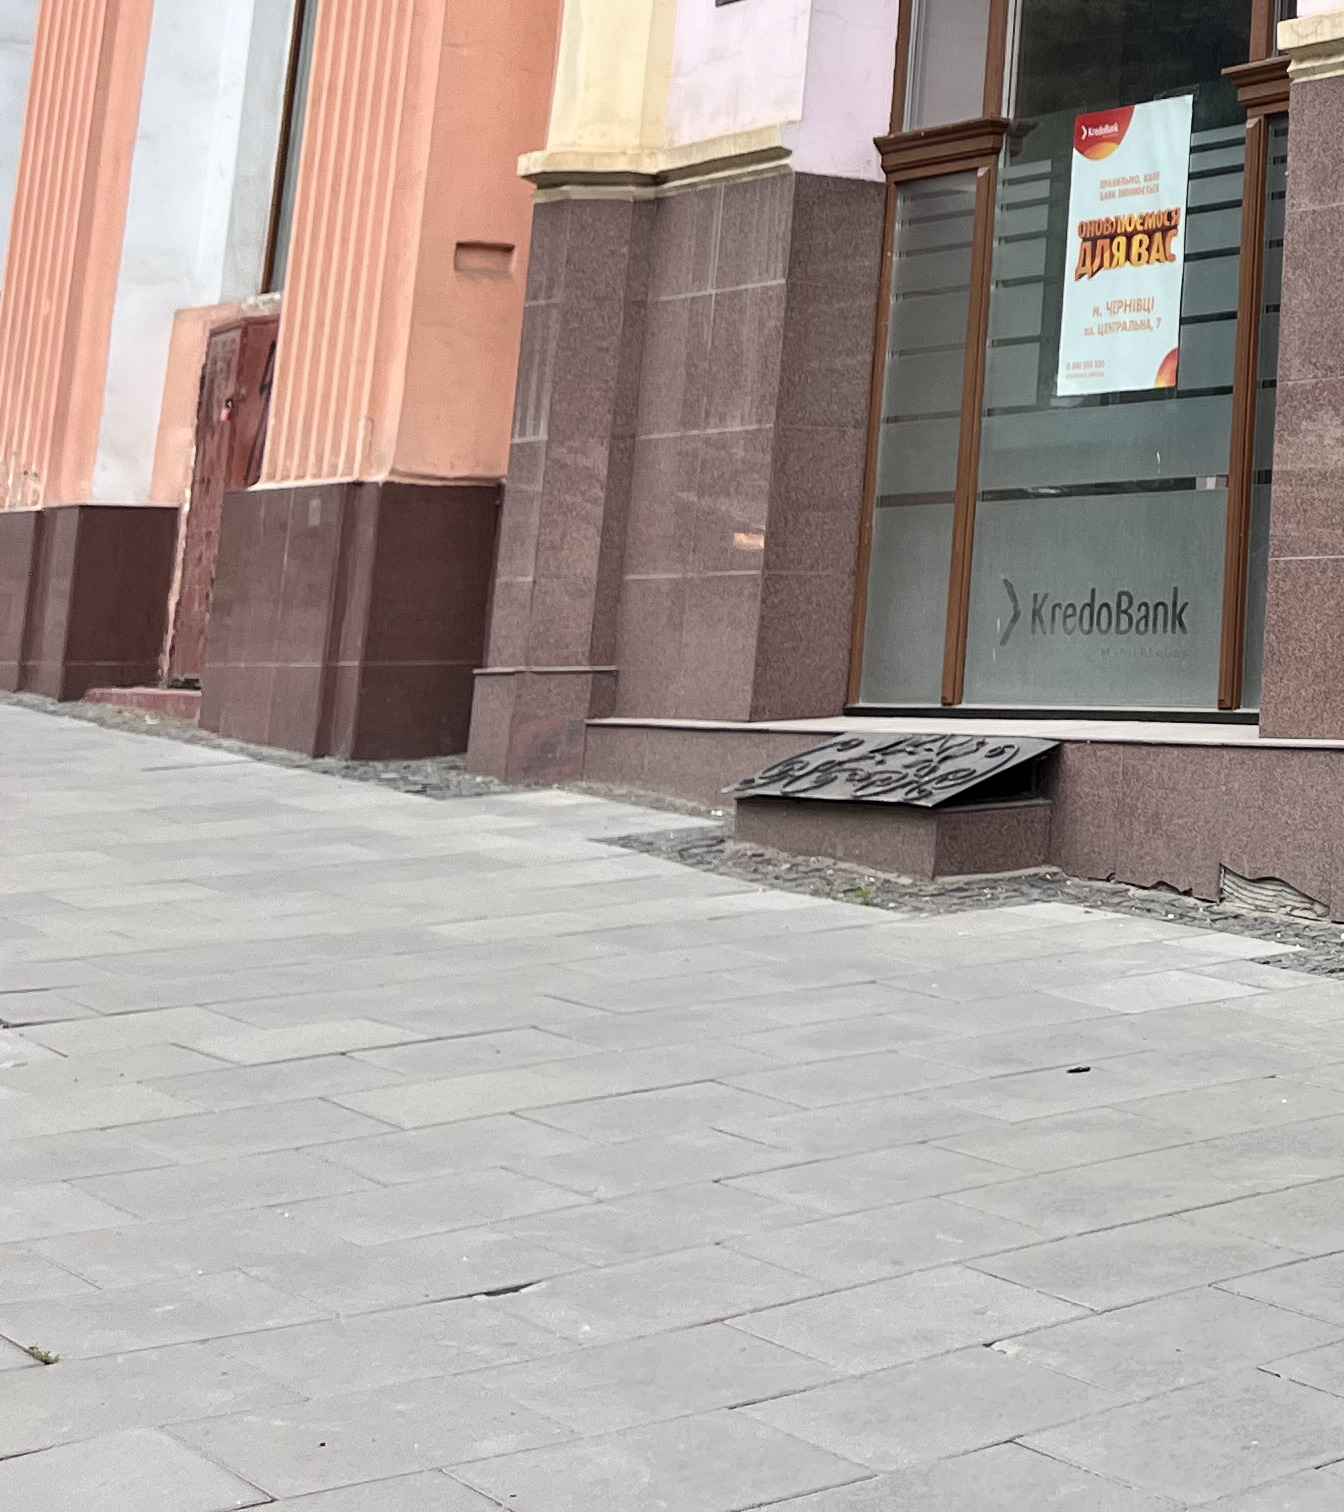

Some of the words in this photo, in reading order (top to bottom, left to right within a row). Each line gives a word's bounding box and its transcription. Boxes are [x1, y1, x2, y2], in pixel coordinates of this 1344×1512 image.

[1075, 235, 1127, 281] ДЛЯ
[1131, 228, 1178, 267] ВАС
[1106, 296, 1155, 317] ЧЕРНІВЦІ
[1031, 586, 1190, 636] KredoBank
